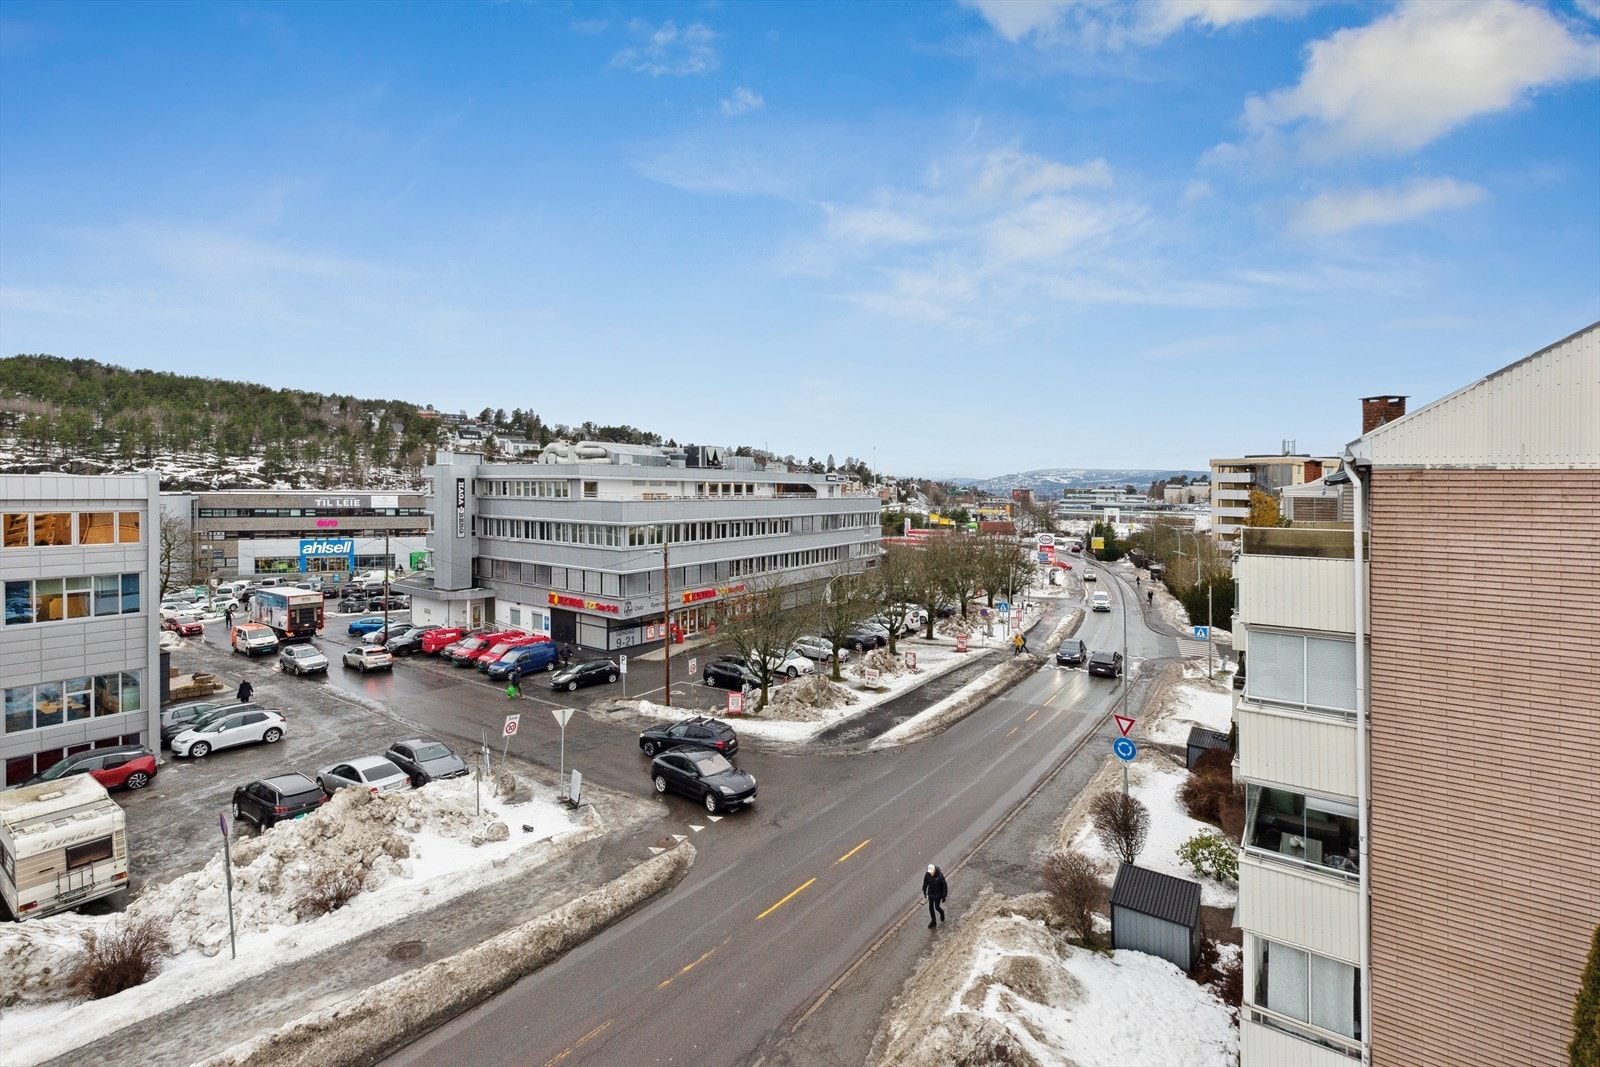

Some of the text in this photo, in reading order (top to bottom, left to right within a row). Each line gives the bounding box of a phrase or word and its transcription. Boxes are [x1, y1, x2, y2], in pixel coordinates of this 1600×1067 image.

[315, 499, 361, 507] TIL LEIE
[302, 541, 352, 554] ahlsell
[650, 601, 661, 609] Ryen
[616, 636, 635, 649] 9-21
